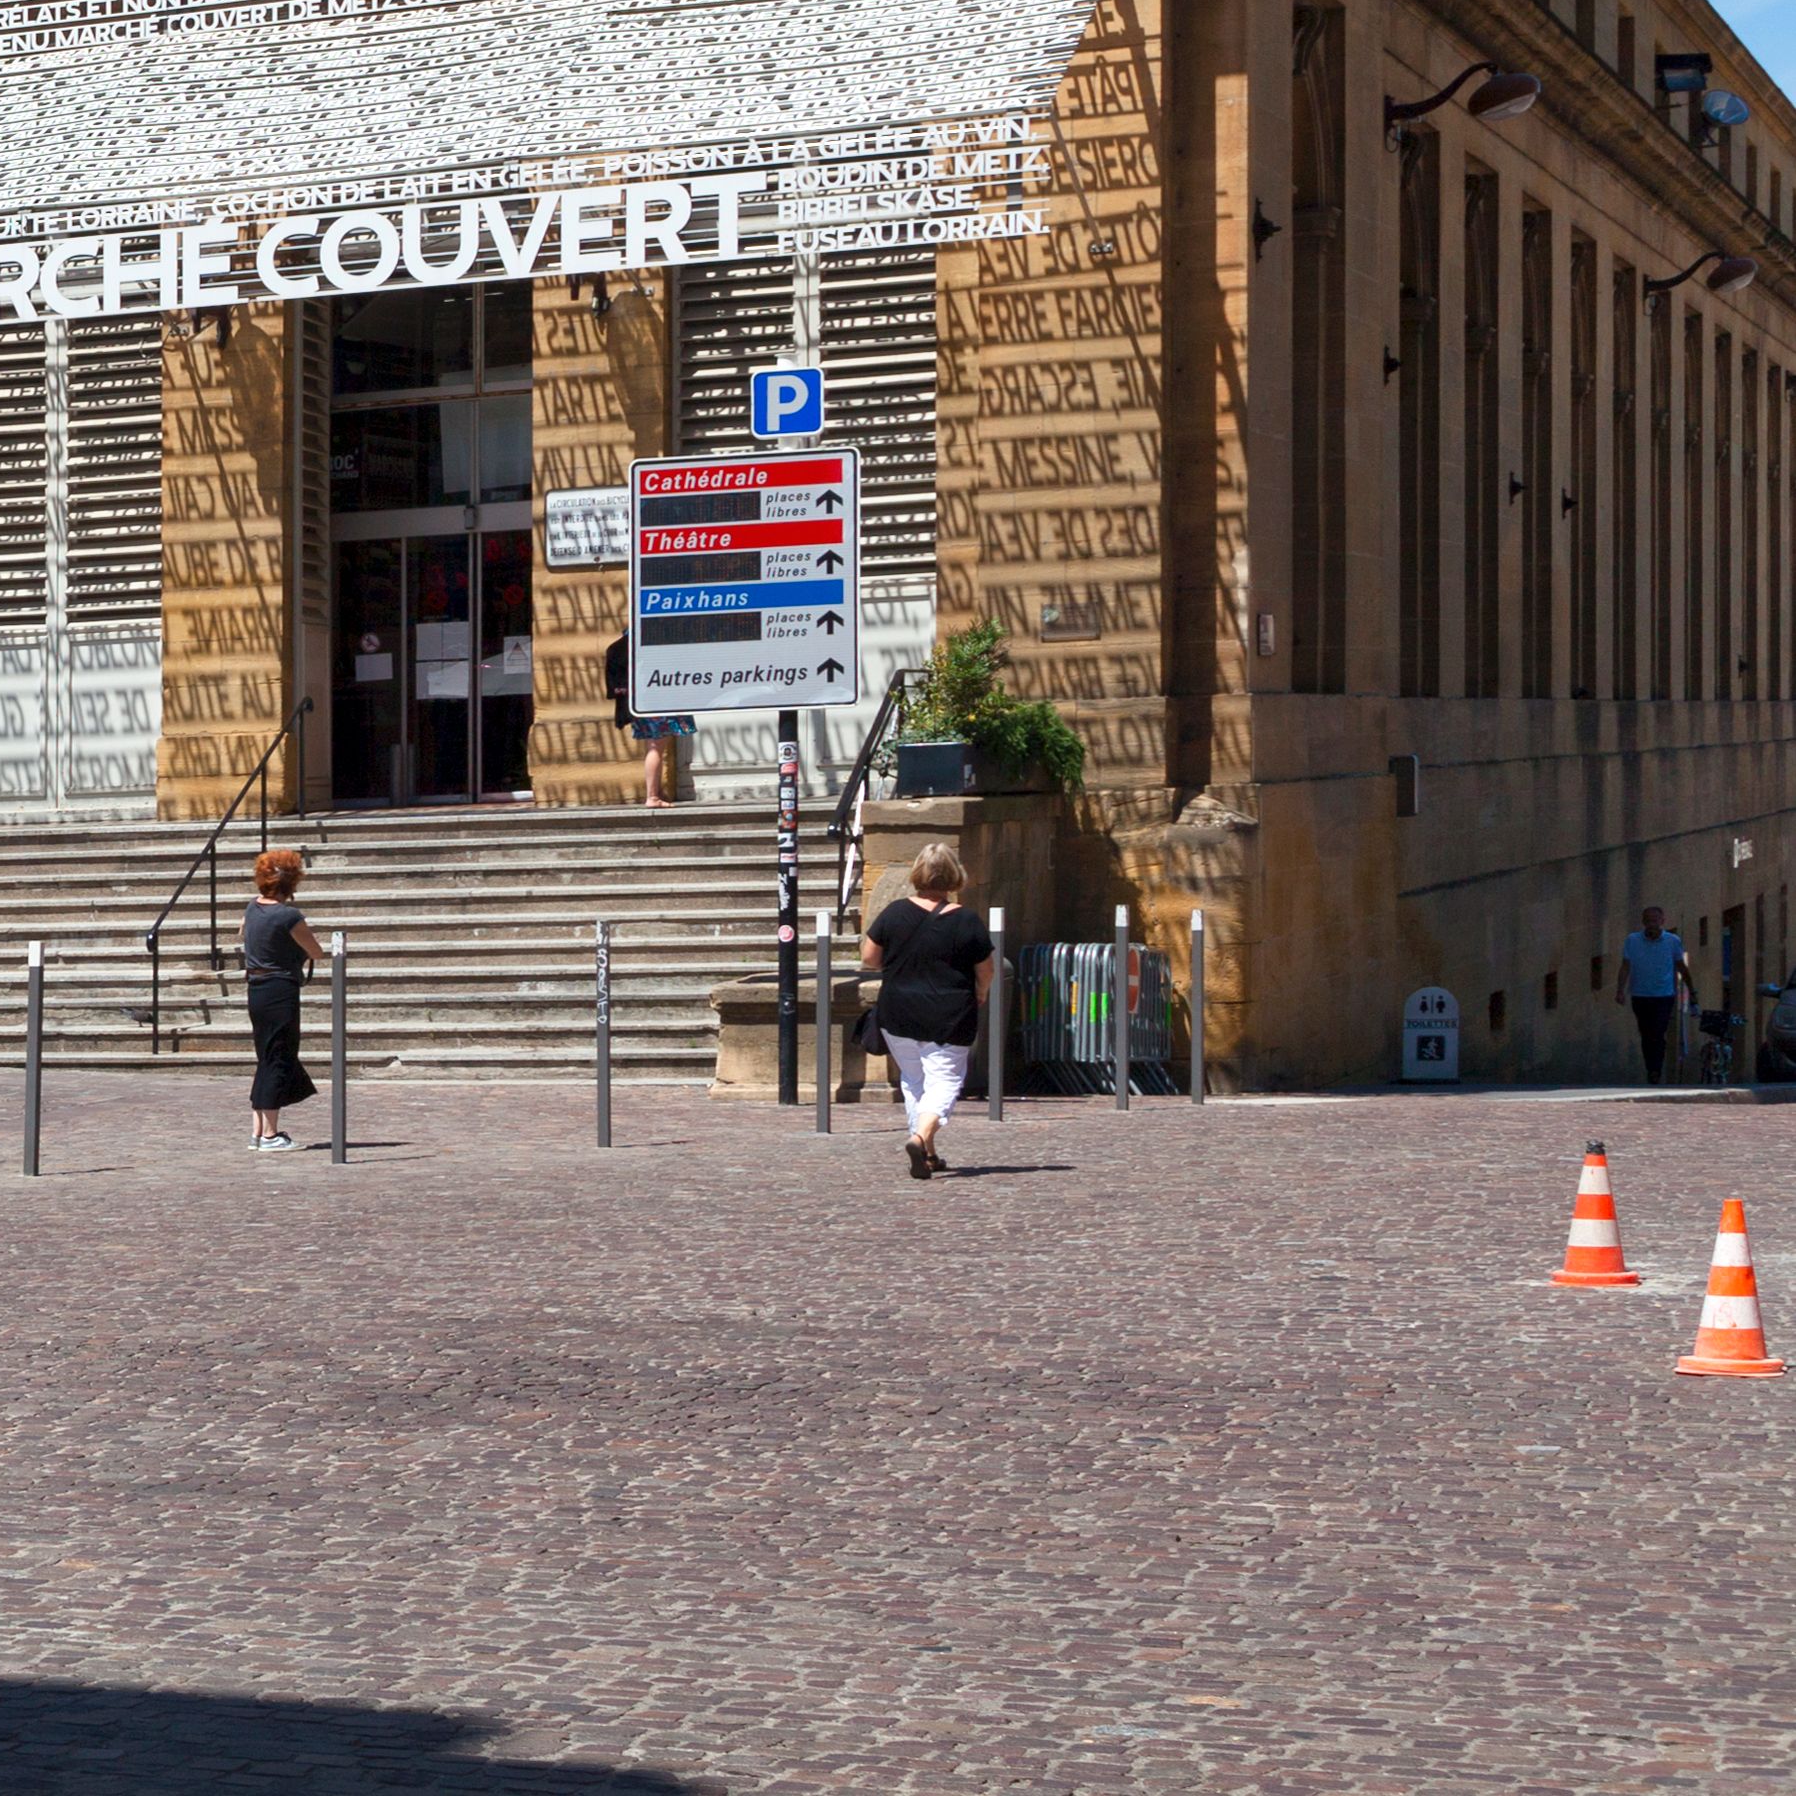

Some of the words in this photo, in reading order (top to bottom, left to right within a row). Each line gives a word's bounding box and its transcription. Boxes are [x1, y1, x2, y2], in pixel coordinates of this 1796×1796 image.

[58, 14, 157, 48] MARCHÉ
[167, 1, 282, 35] COUVERT
[66, 197, 203, 232] LORRAINE,
[212, 184, 338, 218] COCHON
[345, 180, 377, 206] DE
[384, 173, 448, 202] LAIT
[456, 169, 492, 195] EN
[499, 157, 595, 191] GELÉE,
[604, 145, 735, 181] POISSON
[742, 140, 765, 167] À
[773, 138, 810, 164] LA
[818, 125, 913, 160] GELÉE
[921, 122, 967, 150] AU
[974, 115, 1038, 145] VIN,
[779, 160, 901, 192] BOUDIN
[908, 156, 946, 182] DE
[955, 147, 1049, 179] METZ,
[779, 185, 981, 223] BIBBELSKÄSE,
[257, 172, 768, 299] COUVERT
[779, 222, 898, 254] FUSEAU
[906, 210, 1049, 245] LORRAIN.
[767, 375, 809, 432] P
[644, 468, 768, 491] Cathédrale
[766, 491, 811, 505] places
[766, 507, 806, 518] libres
[645, 532, 732, 551] Théâtre
[766, 551, 811, 565] places
[767, 566, 807, 578] libres
[646, 591, 749, 610] Paixhans
[766, 611, 812, 626] places
[767, 627, 808, 638] libres
[647, 670, 713, 688] Autres
[720, 665, 808, 688] parkings
[1406, 1019, 1457, 1028] TOILETTES
